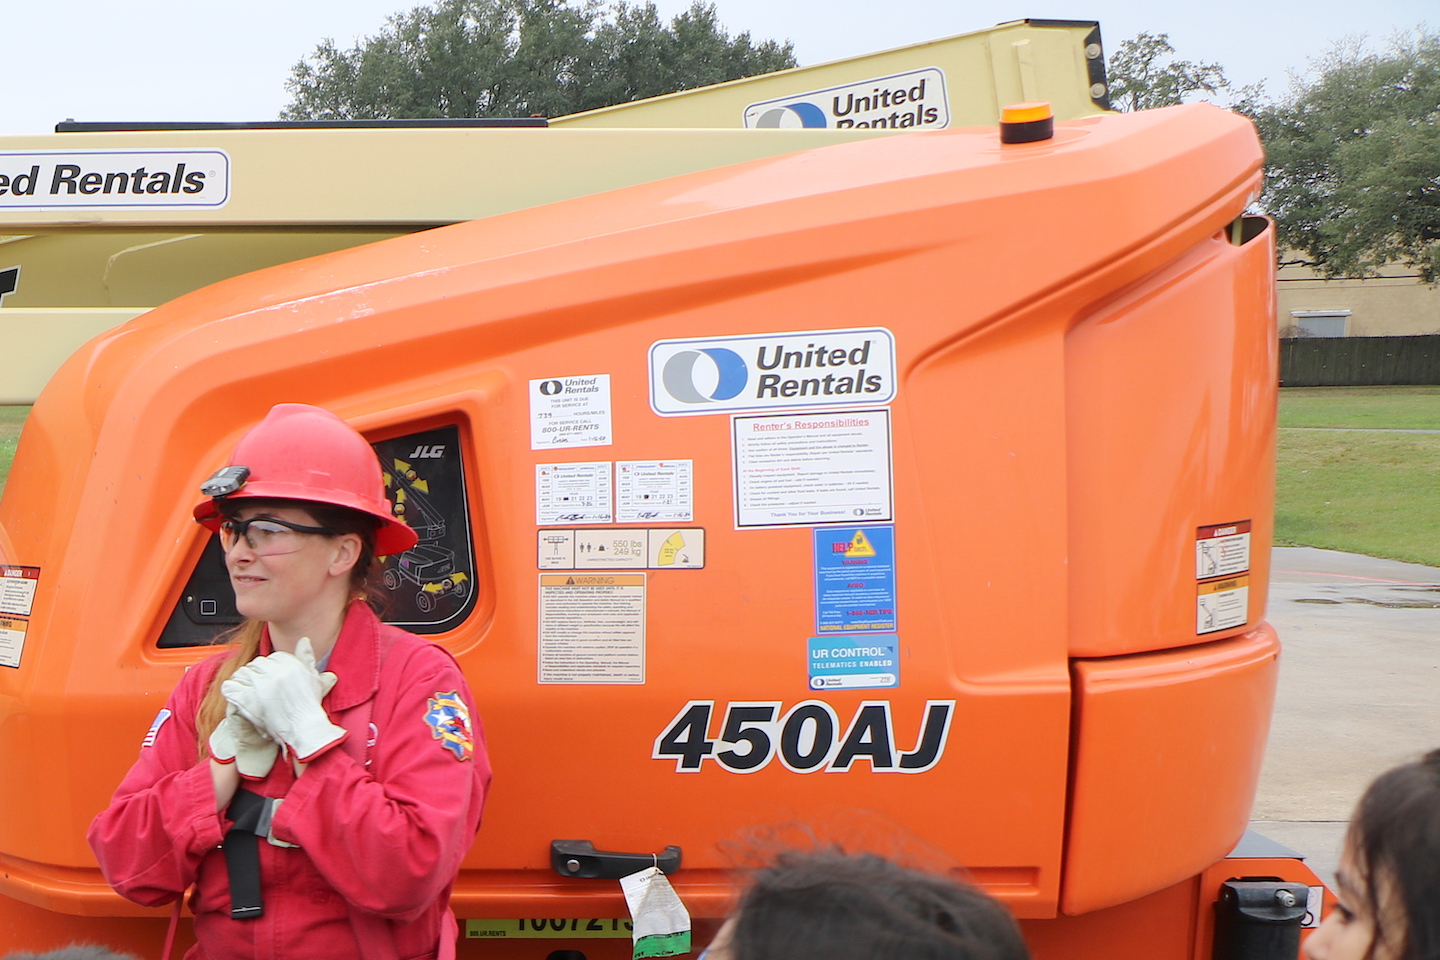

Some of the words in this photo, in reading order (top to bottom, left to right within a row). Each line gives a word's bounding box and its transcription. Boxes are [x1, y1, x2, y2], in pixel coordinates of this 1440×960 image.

[832, 78, 926, 117] United
[49, 163, 206, 195] Rentals
[756, 340, 871, 371] United
[565, 378, 597, 386] United
[756, 369, 882, 399] Rentals
[565, 386, 599, 394] Rentals
[542, 424, 599, 433] 800-UR-RENTS
[753, 422, 792, 431] Renter's
[795, 418, 870, 429] Responsibilities
[409, 445, 446, 458] JLG
[630, 540, 642, 548] lbs
[833, 542, 853, 553] HELP
[631, 548, 641, 557] kg
[812, 649, 828, 658] UR
[831, 647, 885, 658] CONTROL
[656, 702, 953, 771] 450AJ
